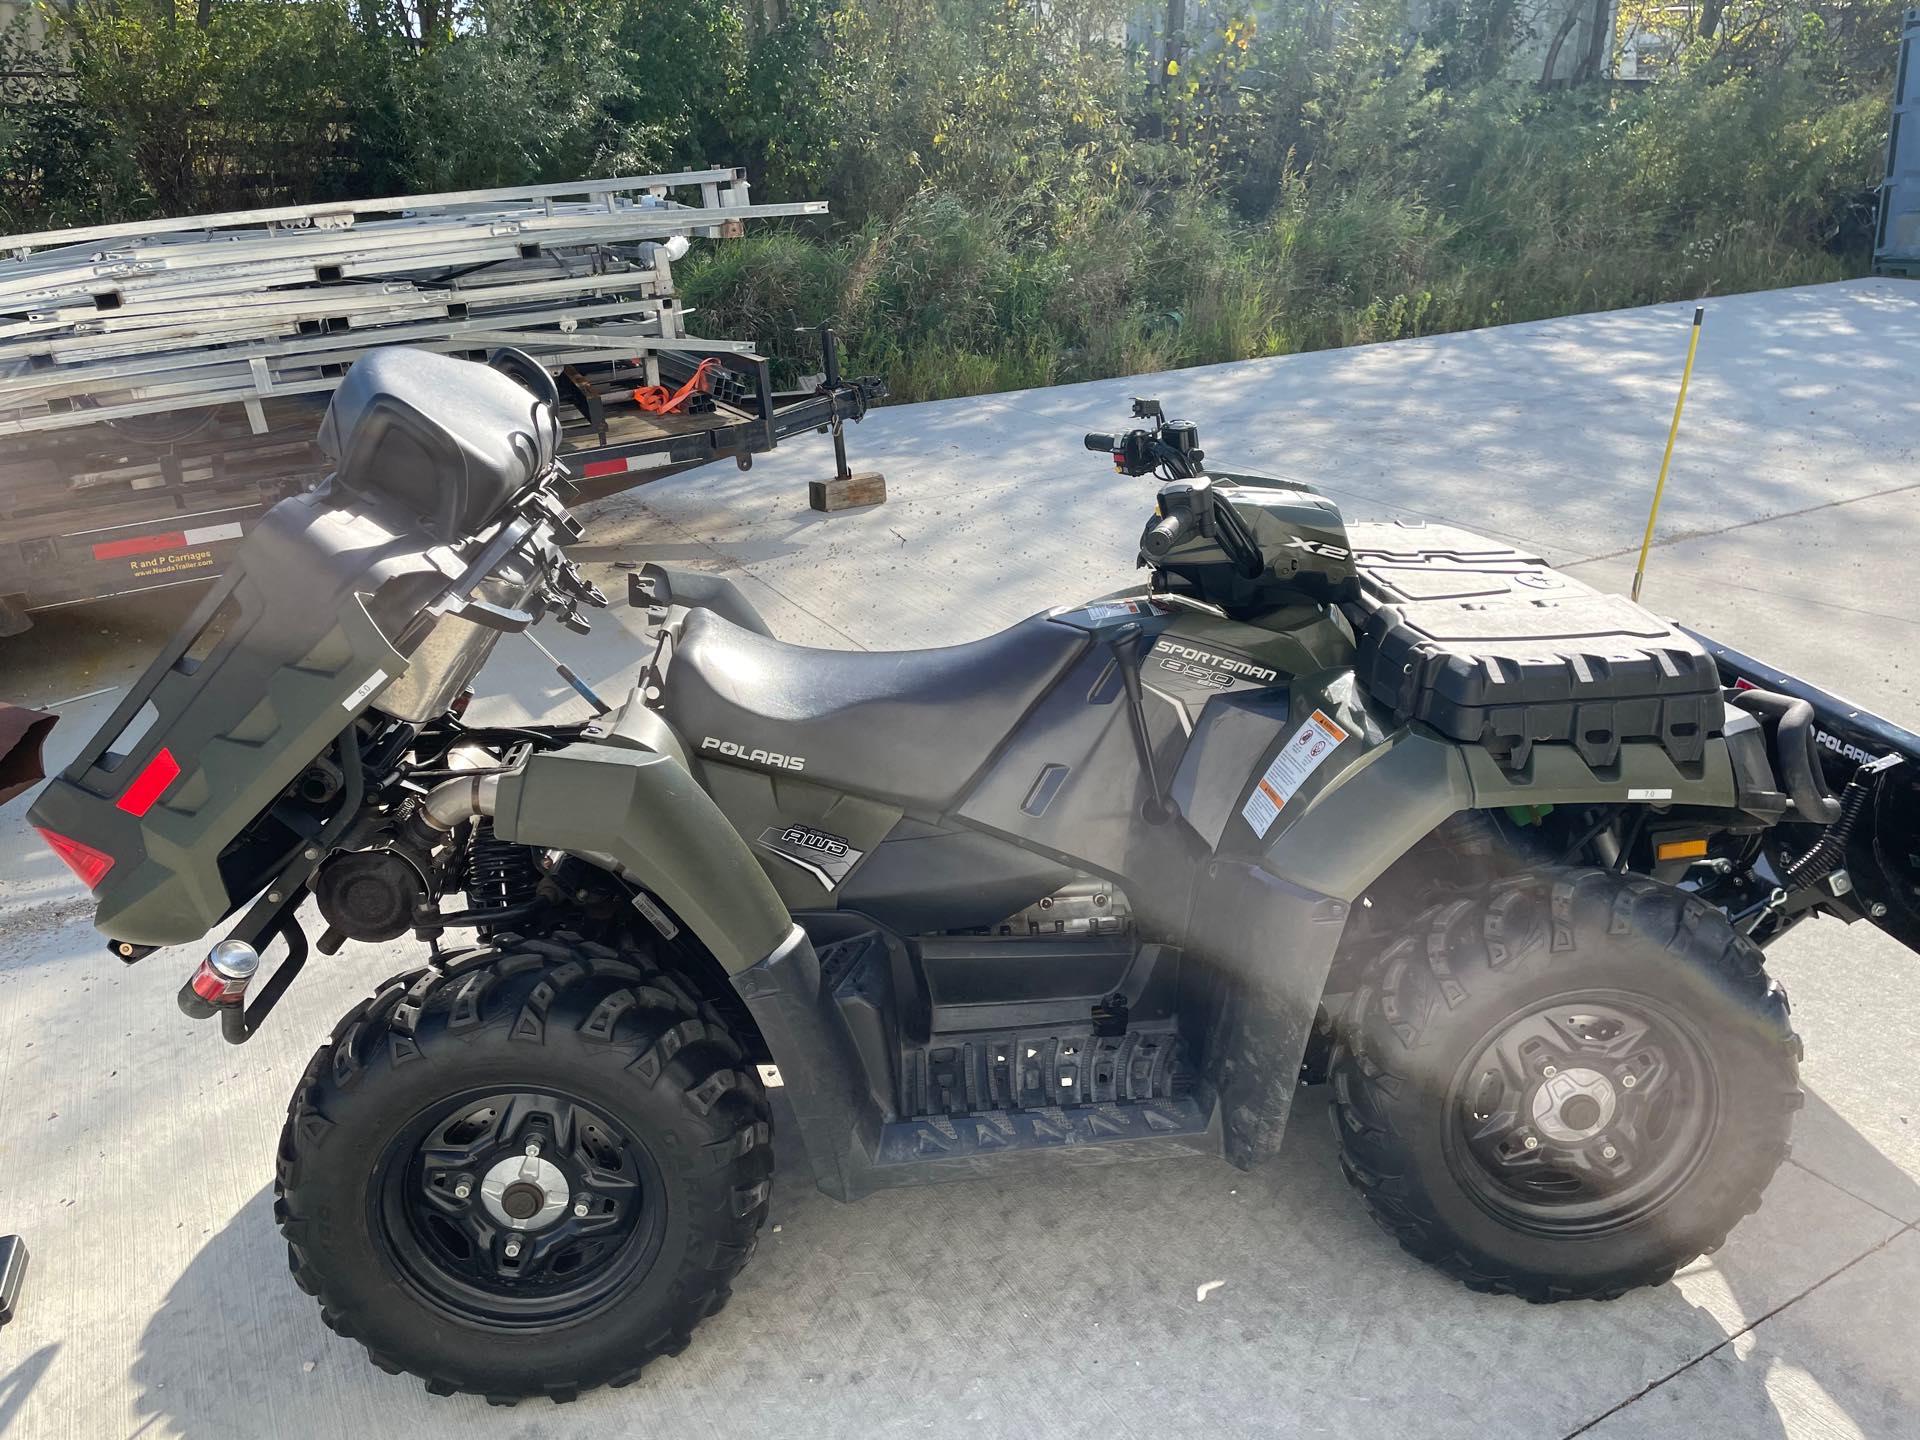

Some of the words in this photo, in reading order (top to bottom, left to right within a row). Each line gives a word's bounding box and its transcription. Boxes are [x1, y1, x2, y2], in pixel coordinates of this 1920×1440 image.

[131, 561, 138, 569] R
[140, 558, 157, 568] and
[159, 556, 166, 565] P
[168, 551, 211, 563] Carriages
[1282, 535, 1350, 560] X2
[1155, 641, 1278, 681] SPORTSMAN
[1160, 658, 1236, 687] 850
[701, 736, 806, 771] POLARIS
[781, 828, 849, 857] AWD
